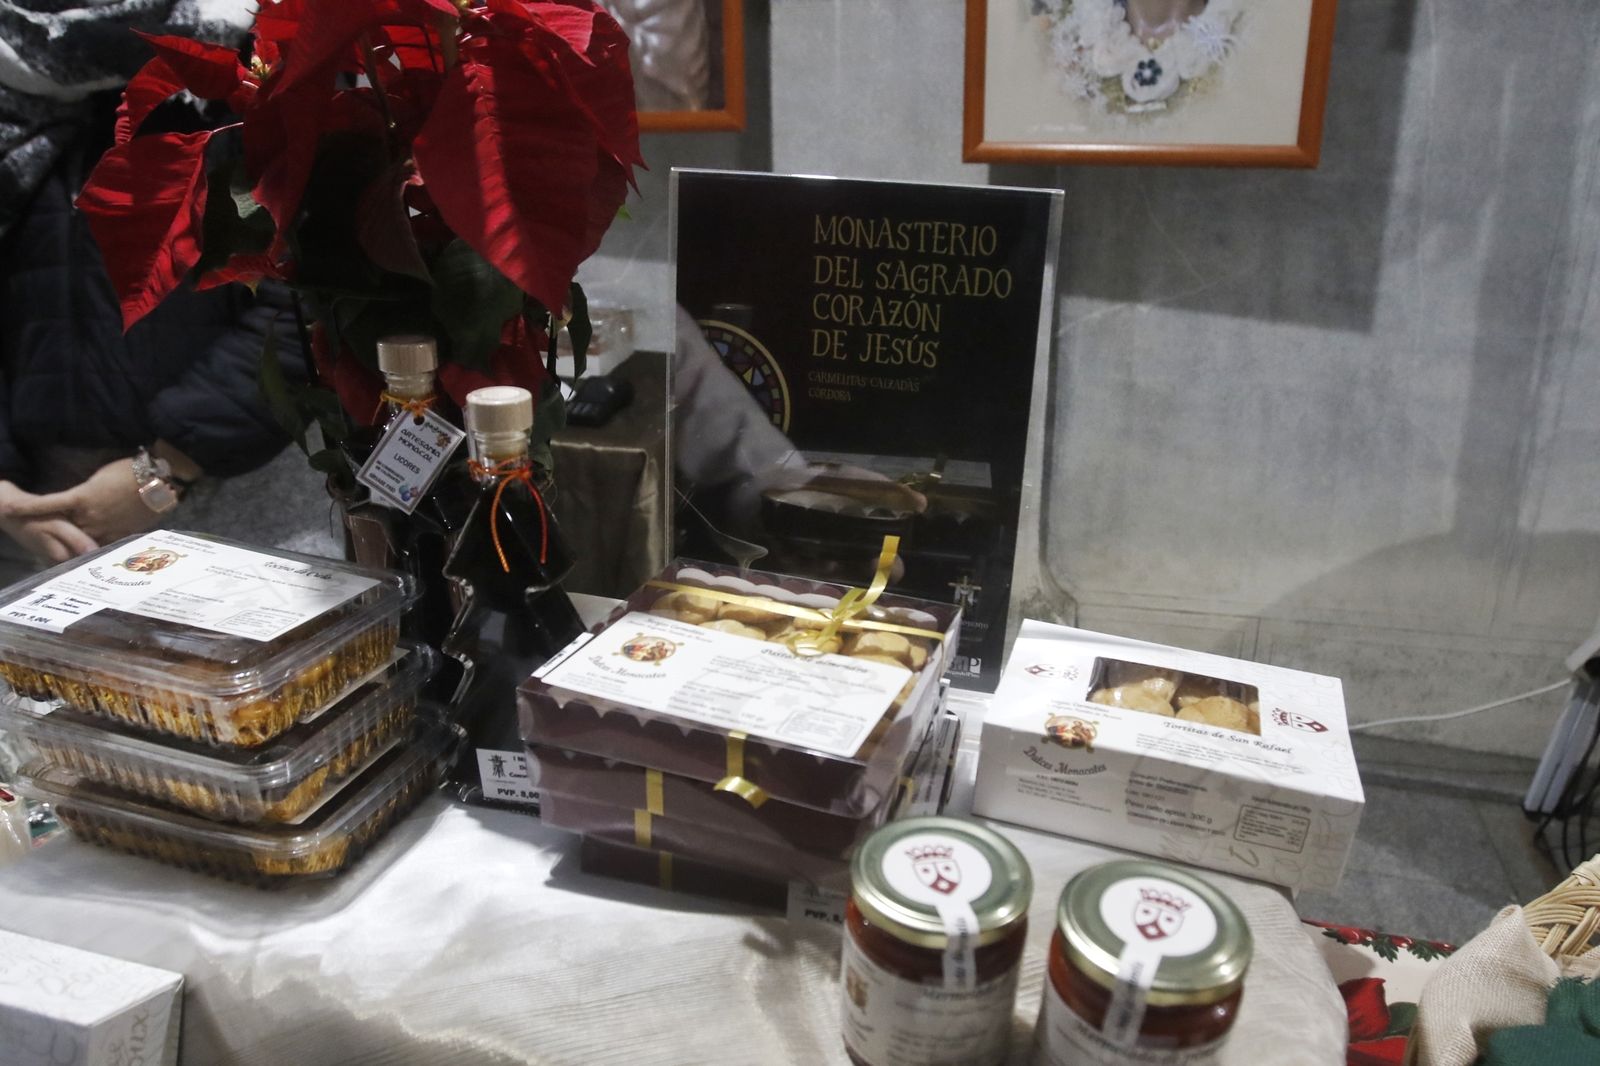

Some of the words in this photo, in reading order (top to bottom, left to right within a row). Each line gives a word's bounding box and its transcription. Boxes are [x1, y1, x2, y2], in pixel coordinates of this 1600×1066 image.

[813, 214, 997, 257] MONASTERIO
[814, 255, 864, 289] DEL
[875, 259, 1012, 299] SAGRADO
[812, 292, 941, 333] CORAZÓN
[811, 328, 848, 360] DE
[859, 333, 941, 369] JESÚS
[870, 375, 920, 393] CALZADAS
[393, 452, 421, 474] LICORES
[1162, 721, 1209, 736] Tortitas
[1211, 731, 1225, 739] de
[1226, 735, 1250, 745] San
[1252, 739, 1294, 754] Rafael
[1053, 762, 1108, 777] Monacales
